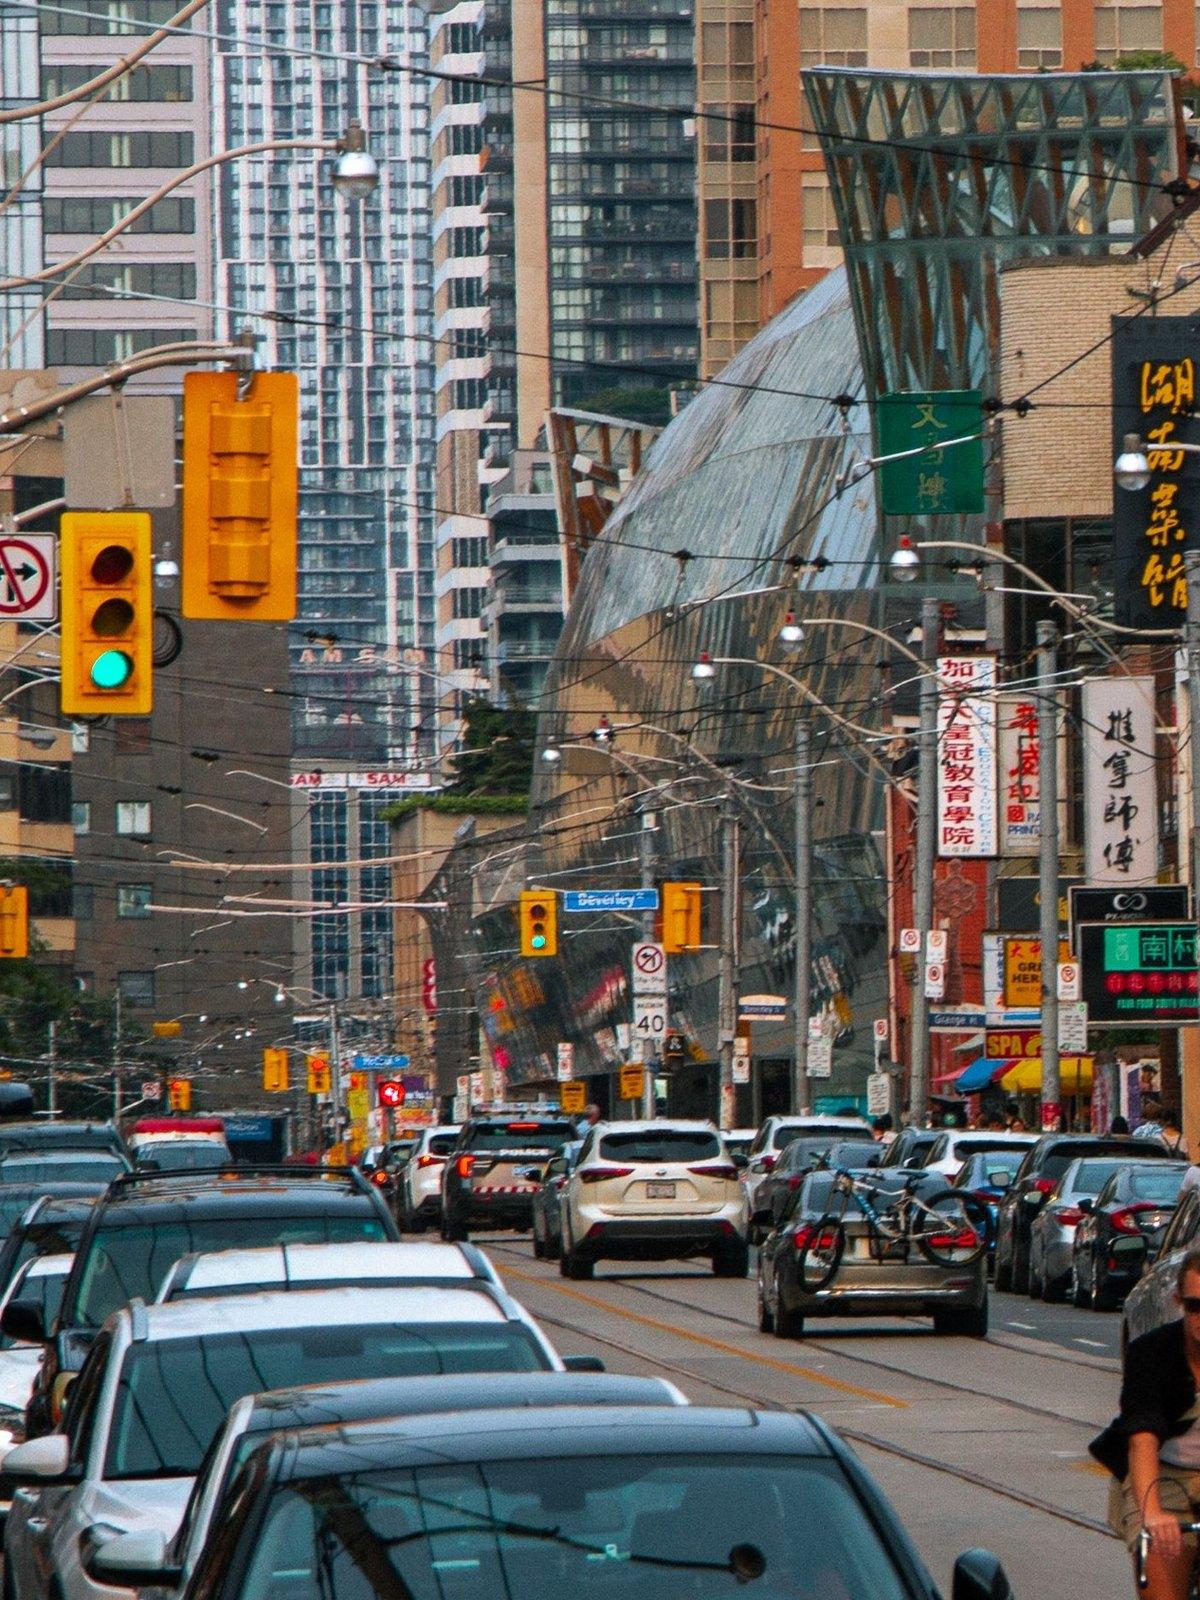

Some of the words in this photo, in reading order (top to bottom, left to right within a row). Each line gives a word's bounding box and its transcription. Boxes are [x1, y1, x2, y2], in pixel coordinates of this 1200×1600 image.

[367, 772, 406, 785] SAM
[1102, 707, 1139, 874] 推拿師傅
[577, 892, 636, 908] Beverley
[636, 1014, 665, 1033] 40
[987, 1034, 1023, 1056] SPA
